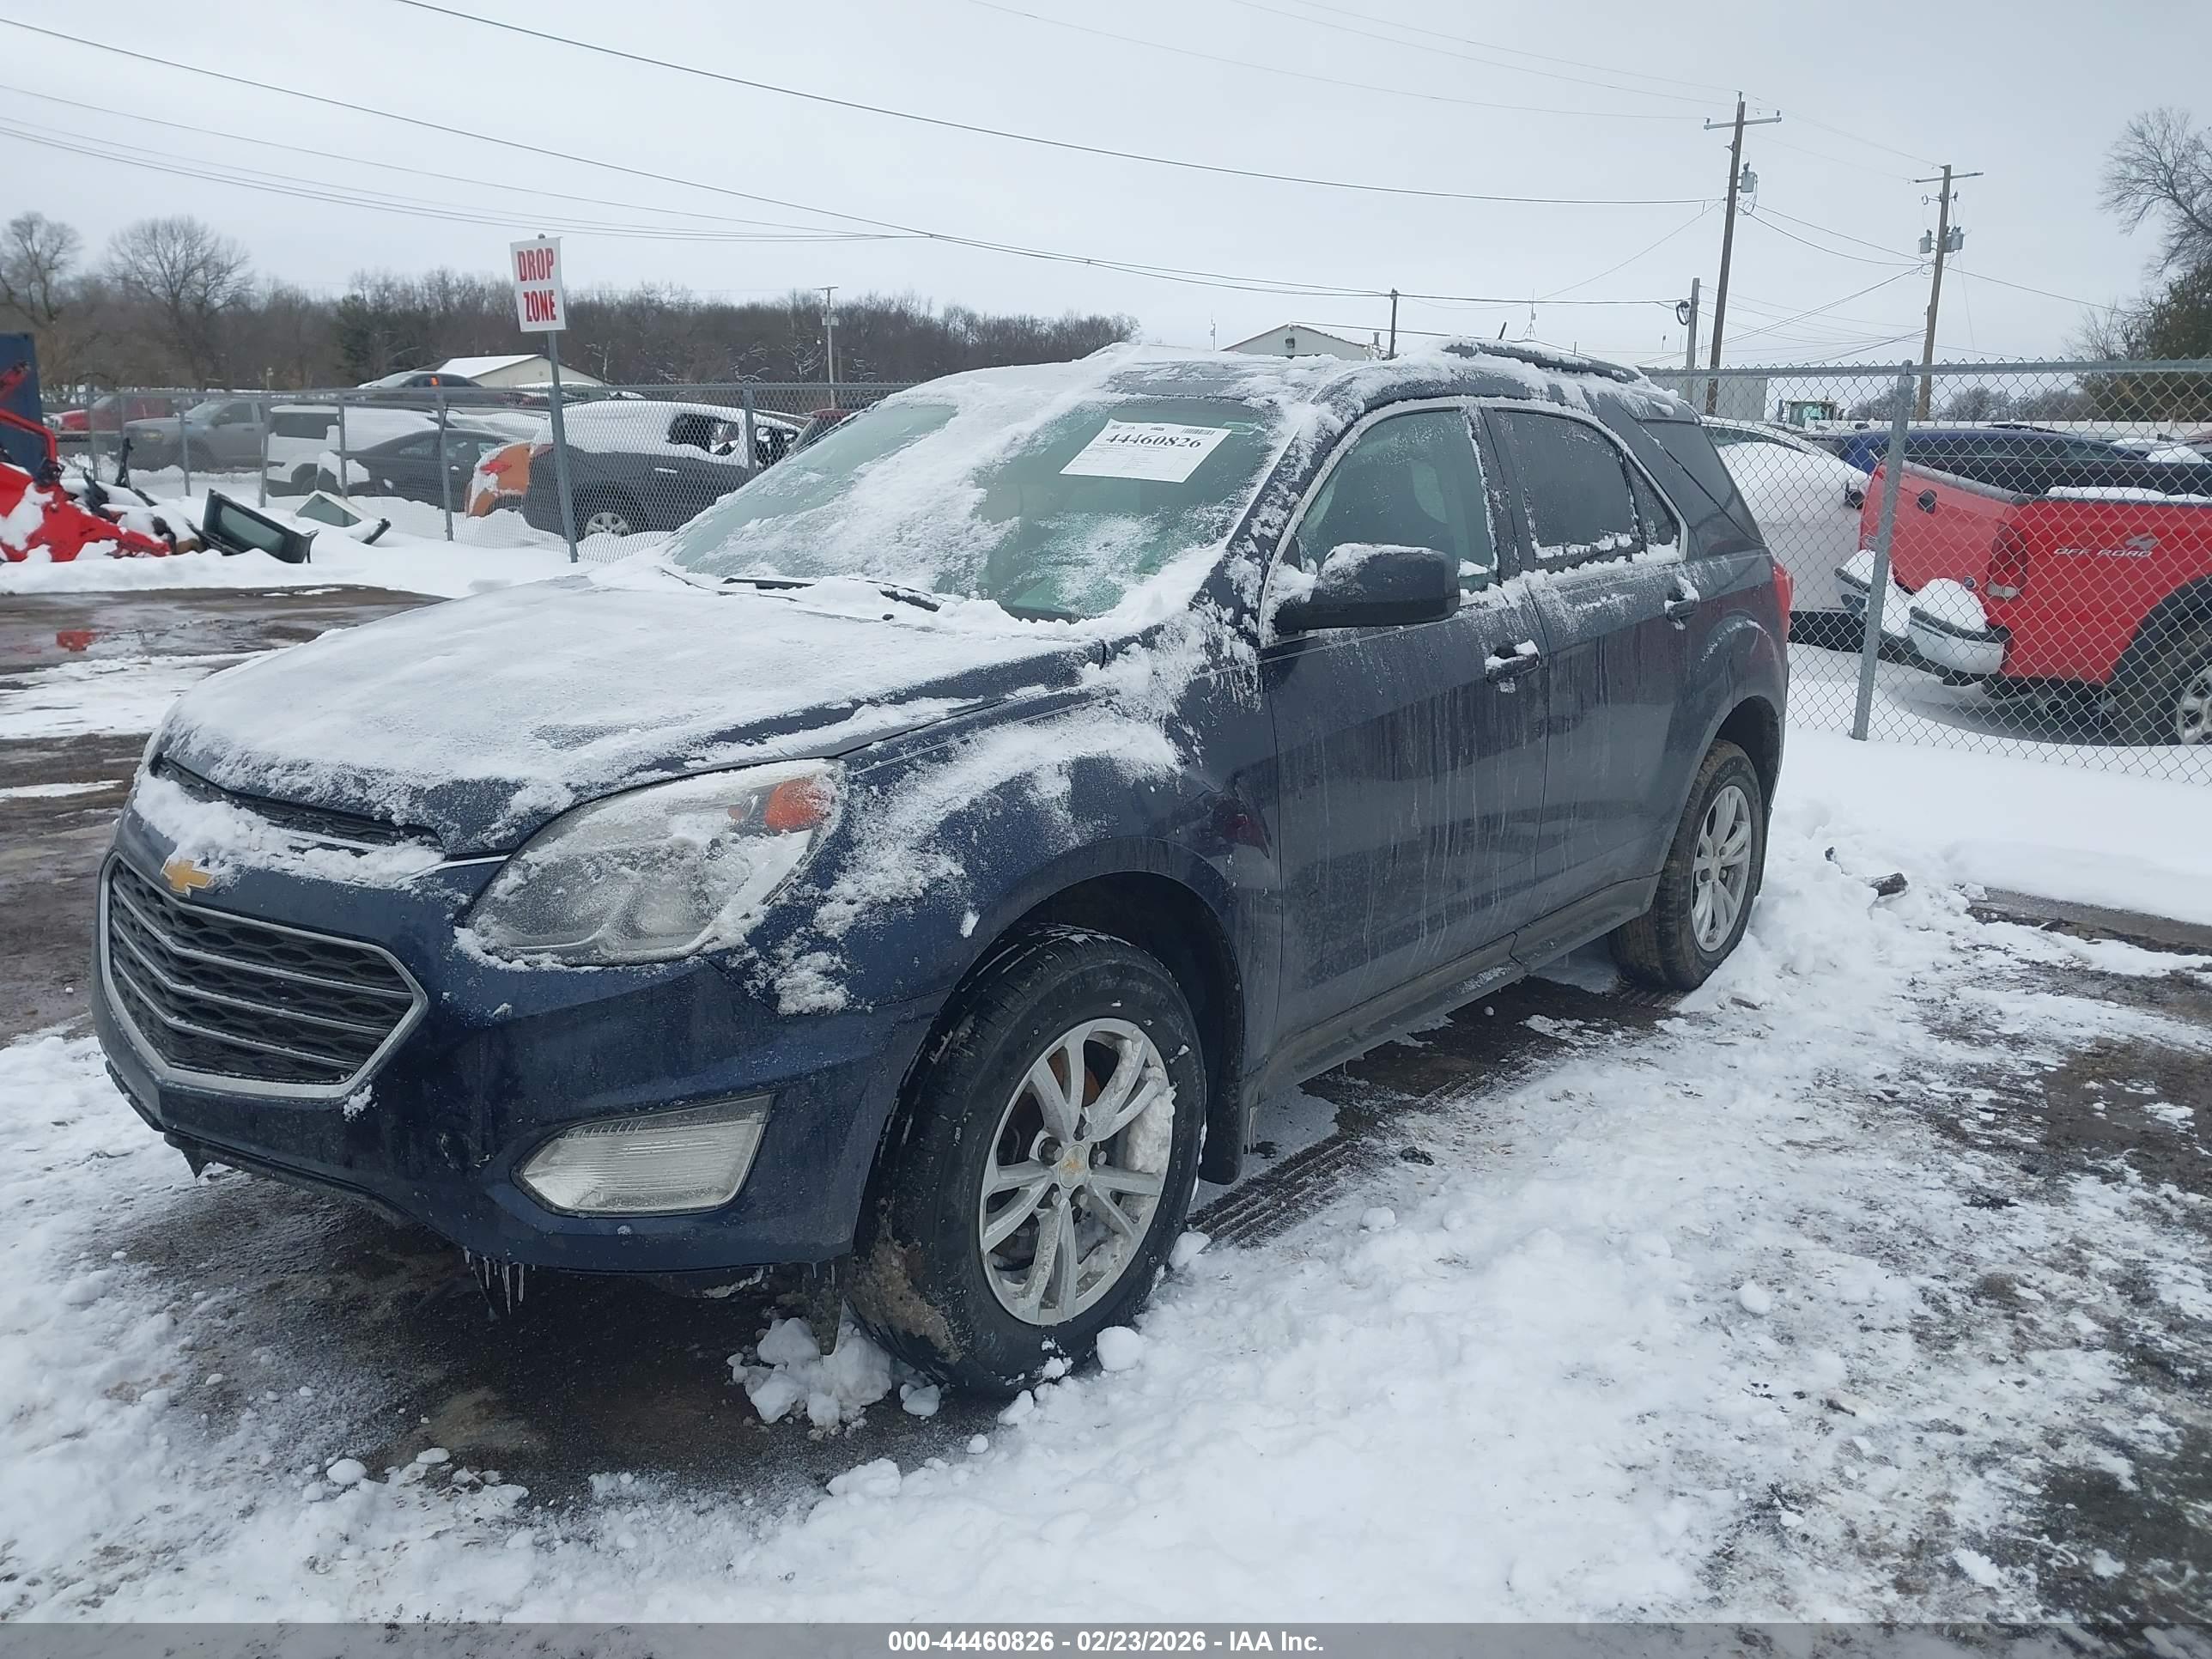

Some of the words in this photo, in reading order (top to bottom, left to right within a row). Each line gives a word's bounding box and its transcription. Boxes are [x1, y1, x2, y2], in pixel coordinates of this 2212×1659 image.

[517, 247, 554, 282] DROP
[523, 289, 556, 322] ZONE
[1105, 433, 1203, 448] 44460826
[2097, 549, 2153, 557] ROAD
